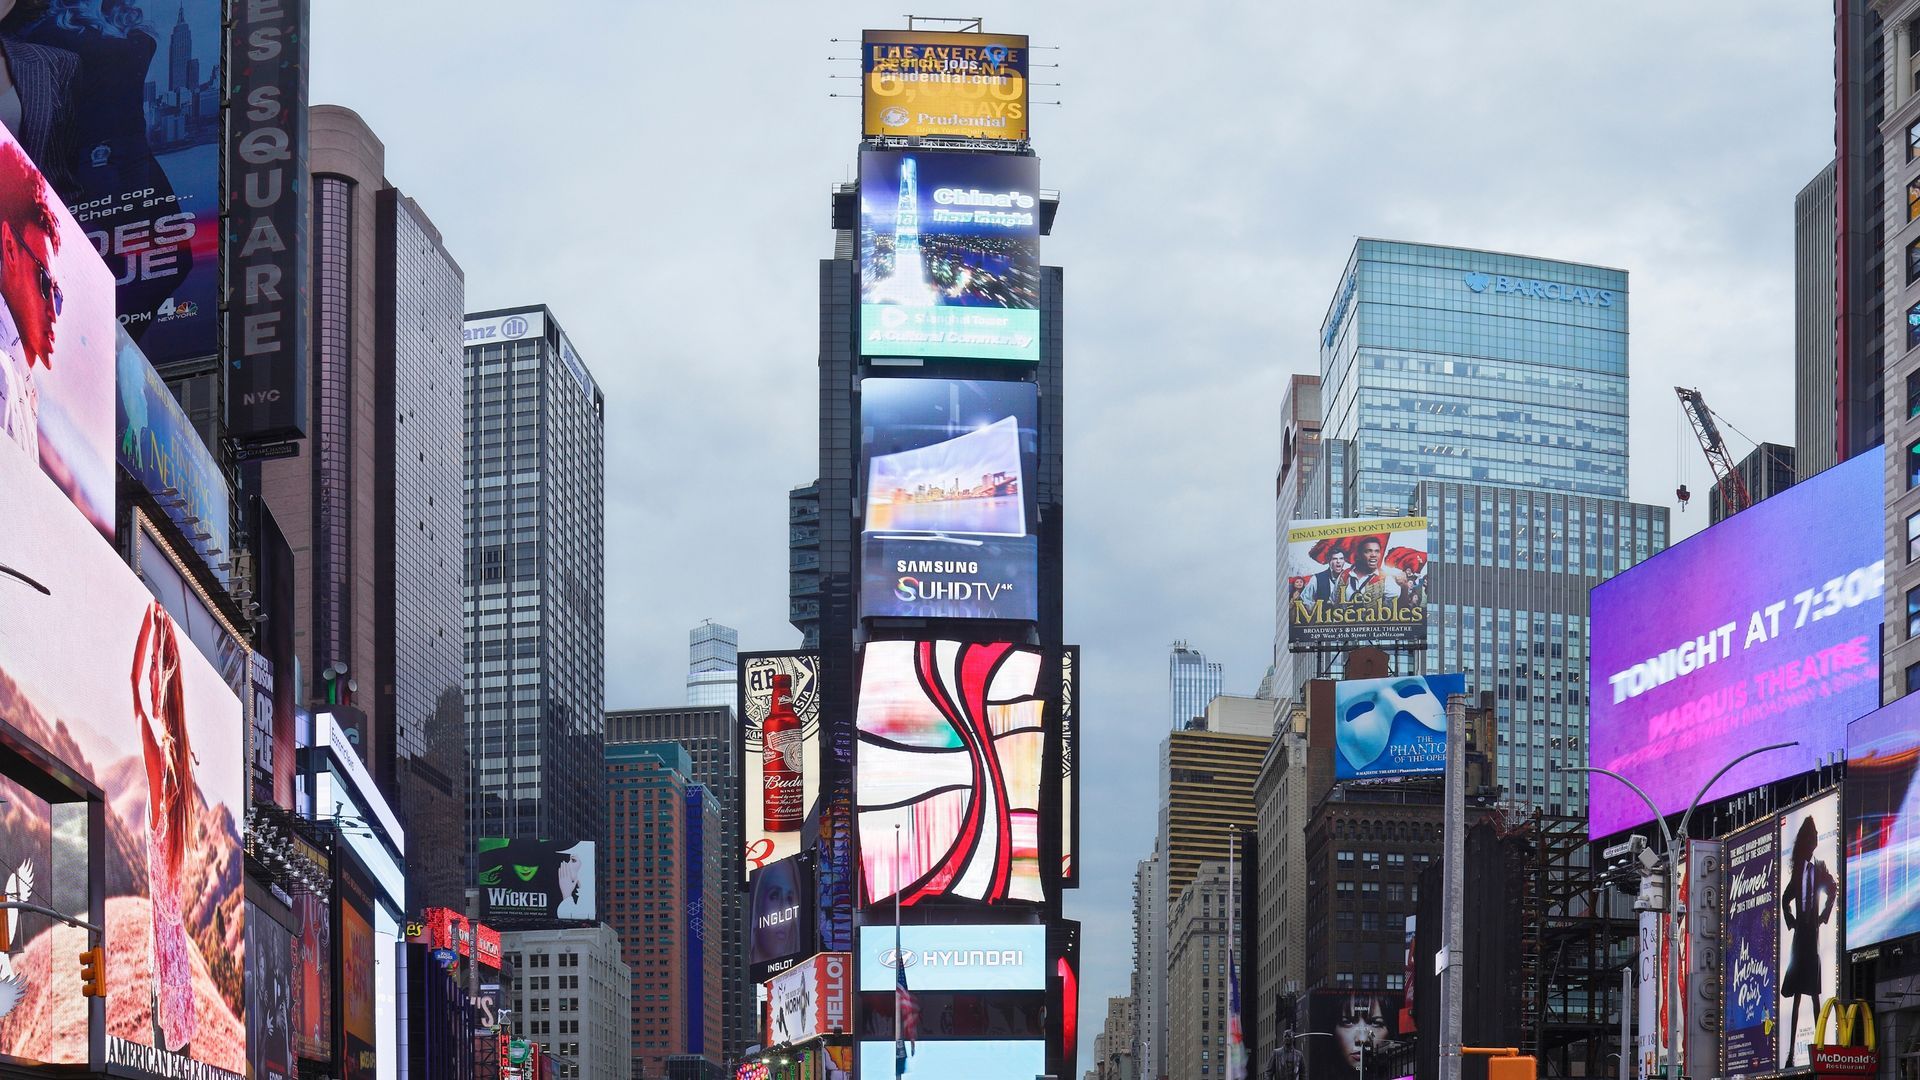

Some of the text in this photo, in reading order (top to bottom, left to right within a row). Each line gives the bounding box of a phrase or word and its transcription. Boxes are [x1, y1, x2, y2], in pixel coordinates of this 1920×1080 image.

[917, 113, 1006, 127] Prudential
[69, 188, 155, 215] good cop
[934, 188, 1034, 208] China's
[79, 203, 134, 222] there
[239, 86, 291, 356] SQUARE
[1496, 275, 1615, 307] BARCLAYS
[158, 298, 177, 316] 4
[177, 311, 197, 319] YORK
[157, 313, 177, 322] NEW
[243, 389, 281, 406] NYC
[1292, 531, 1316, 540] FINAL
[1358, 524, 1384, 532] DON'T
[897, 560, 978, 574] SAMSUNG
[1340, 585, 1372, 604] Les
[1294, 598, 1423, 625] Misérables
[1608, 620, 1736, 705] TONIGHT
[1744, 600, 1786, 650] AT
[1416, 735, 1433, 743] THE
[1390, 742, 1447, 756] PHANTO
[759, 905, 799, 928] INGLOT
[1700, 855, 1717, 1032] PALACE
[768, 959, 794, 973] INGLOT
[923, 951, 1023, 966] HYUNDAI
[827, 957, 843, 1030] HELLO!
[107, 1035, 172, 1078] AMERICAN
[172, 1055, 200, 1080] EAGLE
[1816, 1053, 1876, 1064] McDonald's
